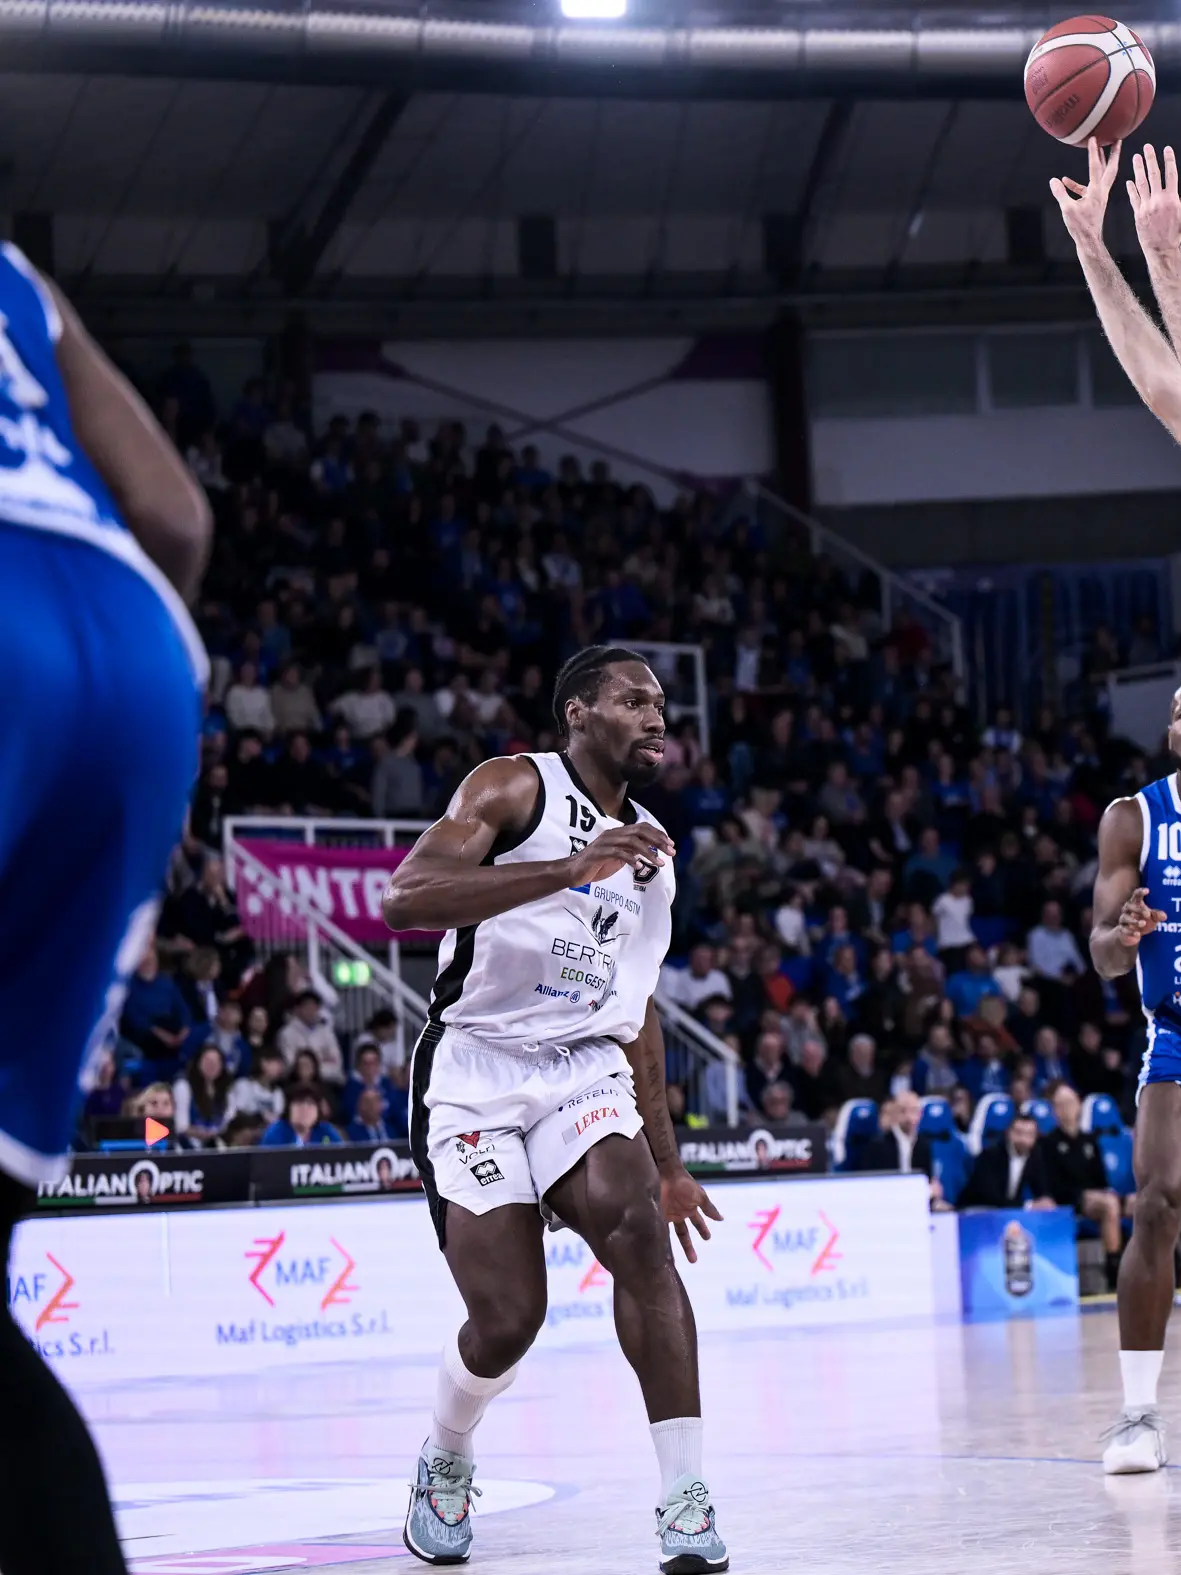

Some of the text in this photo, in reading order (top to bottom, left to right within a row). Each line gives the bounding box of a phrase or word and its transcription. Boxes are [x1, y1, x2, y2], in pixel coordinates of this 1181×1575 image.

[594, 886, 641, 916] GRUPPO ASTM
[534, 983, 570, 998] Allianz
[574, 1106, 620, 1136] LERTA
[275, 1257, 331, 1286] MAF
[216, 1322, 255, 1345] Maf
[261, 1318, 347, 1347] Logistics
